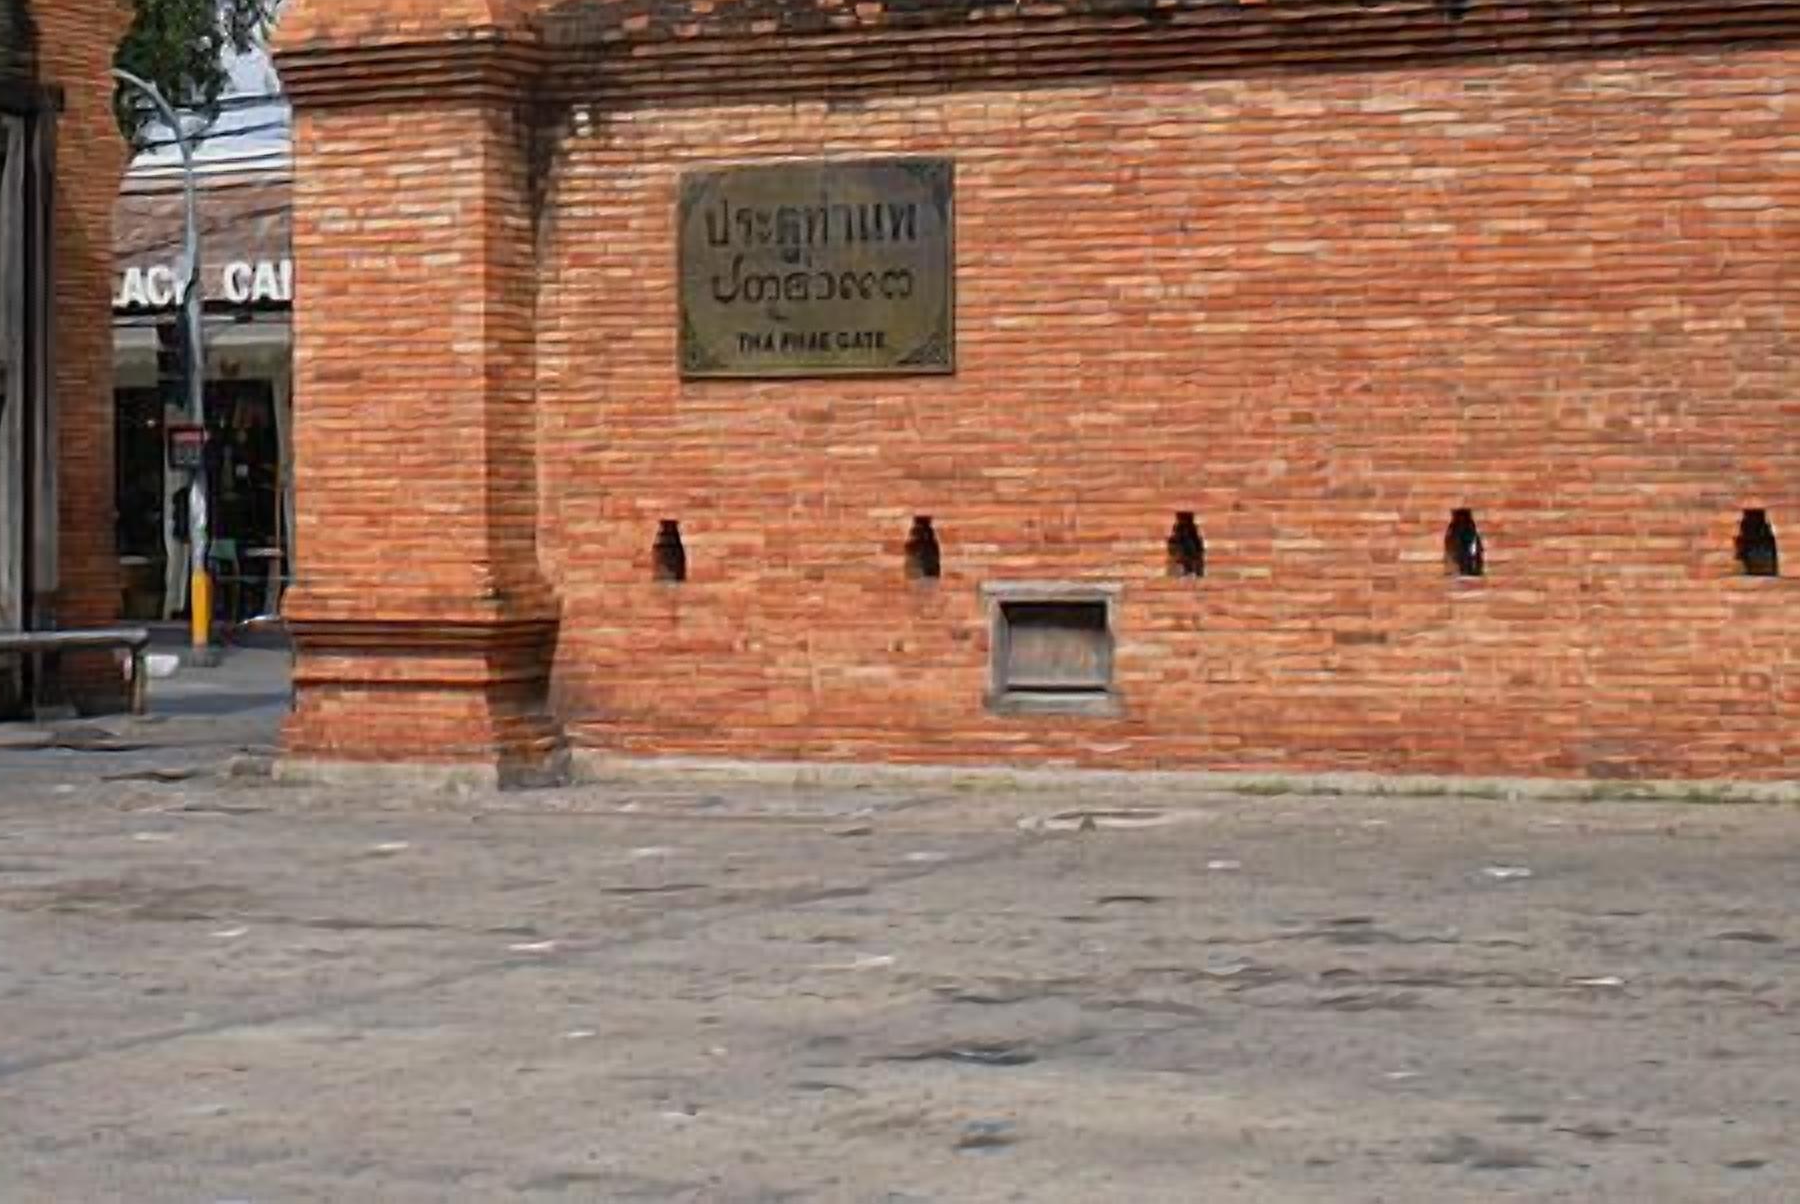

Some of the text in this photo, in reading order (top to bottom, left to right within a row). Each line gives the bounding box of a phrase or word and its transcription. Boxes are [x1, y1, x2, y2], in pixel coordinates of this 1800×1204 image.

[704, 192, 917, 265] ประตูท่าแพ
[737, 331, 886, 352] THA PHAE GATE
